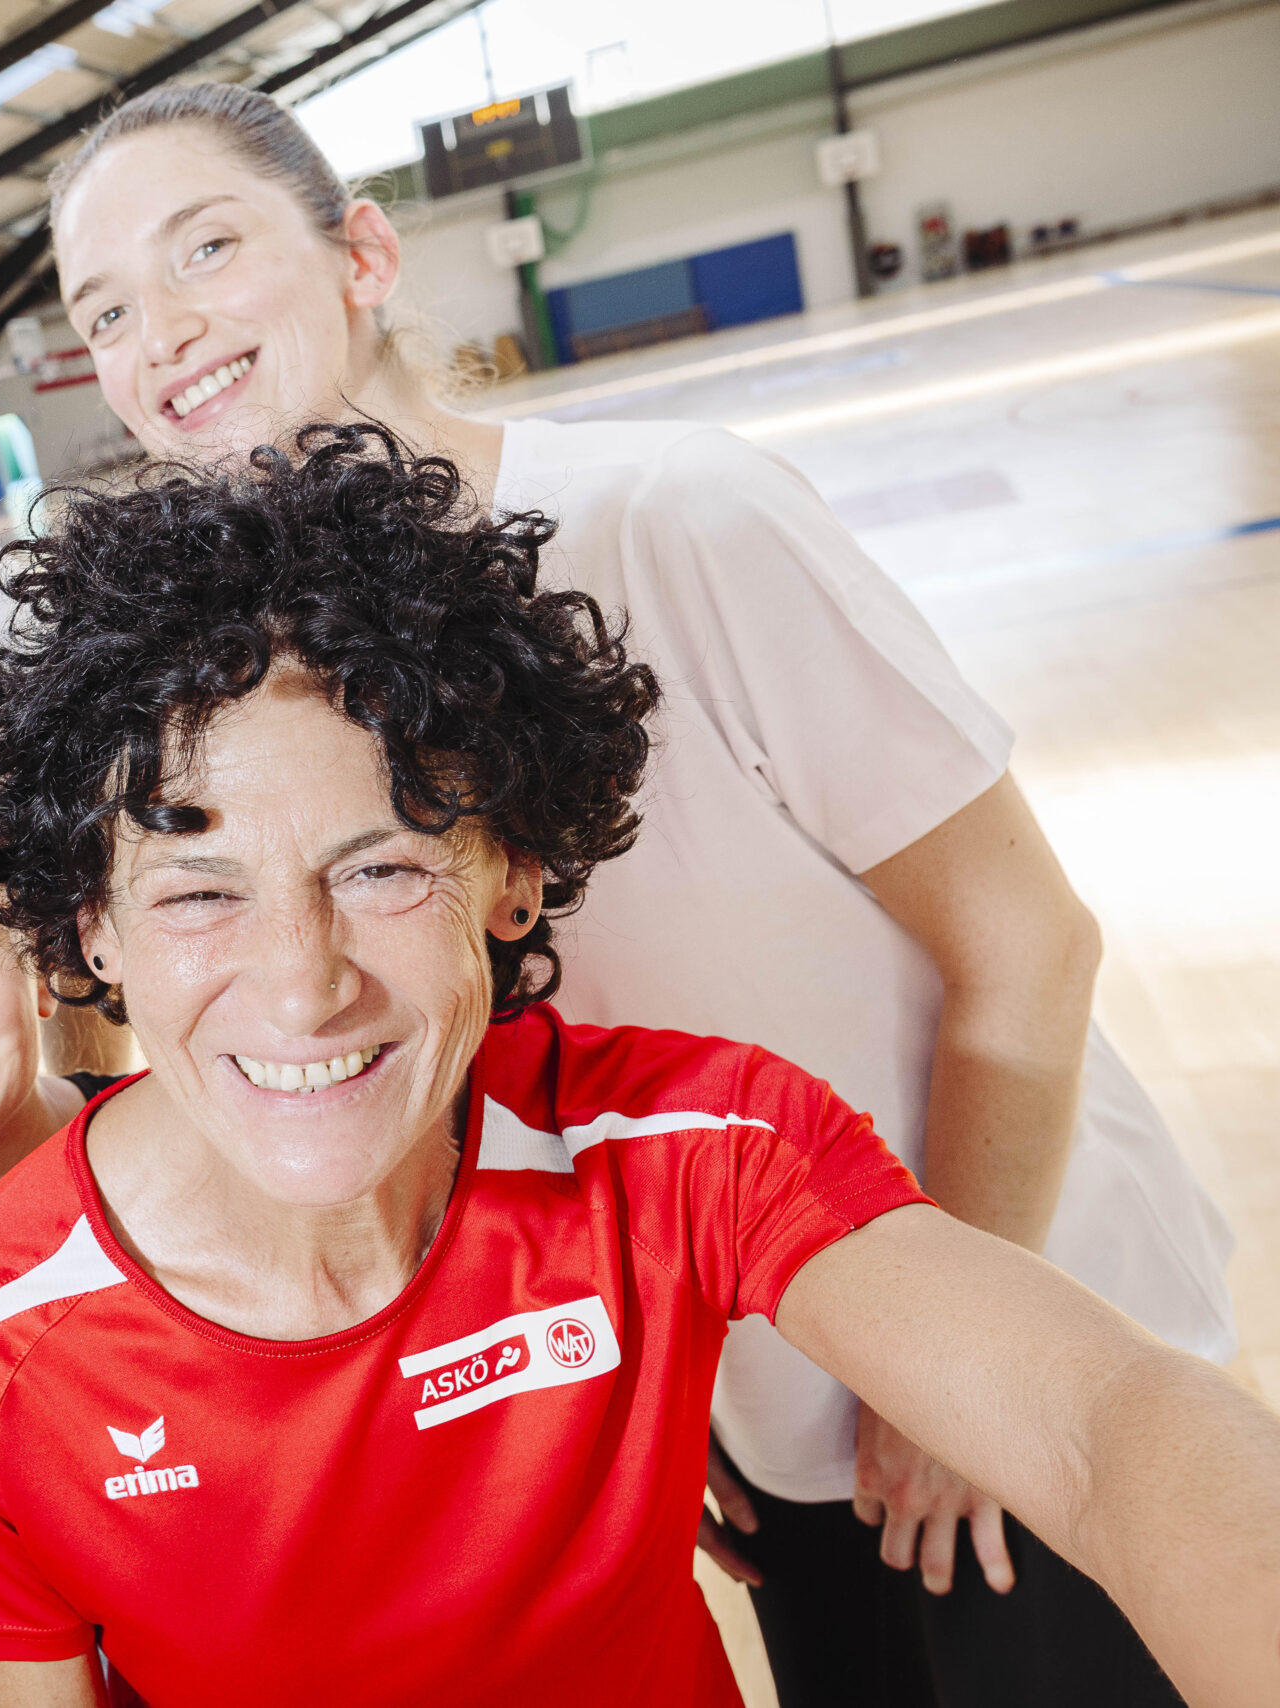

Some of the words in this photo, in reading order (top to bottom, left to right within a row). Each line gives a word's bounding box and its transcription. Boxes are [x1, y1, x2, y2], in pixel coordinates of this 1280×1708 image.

[549, 1322, 591, 1365] WAT
[421, 1354, 488, 1403] ASKÖ
[105, 1464, 199, 1500] erima
